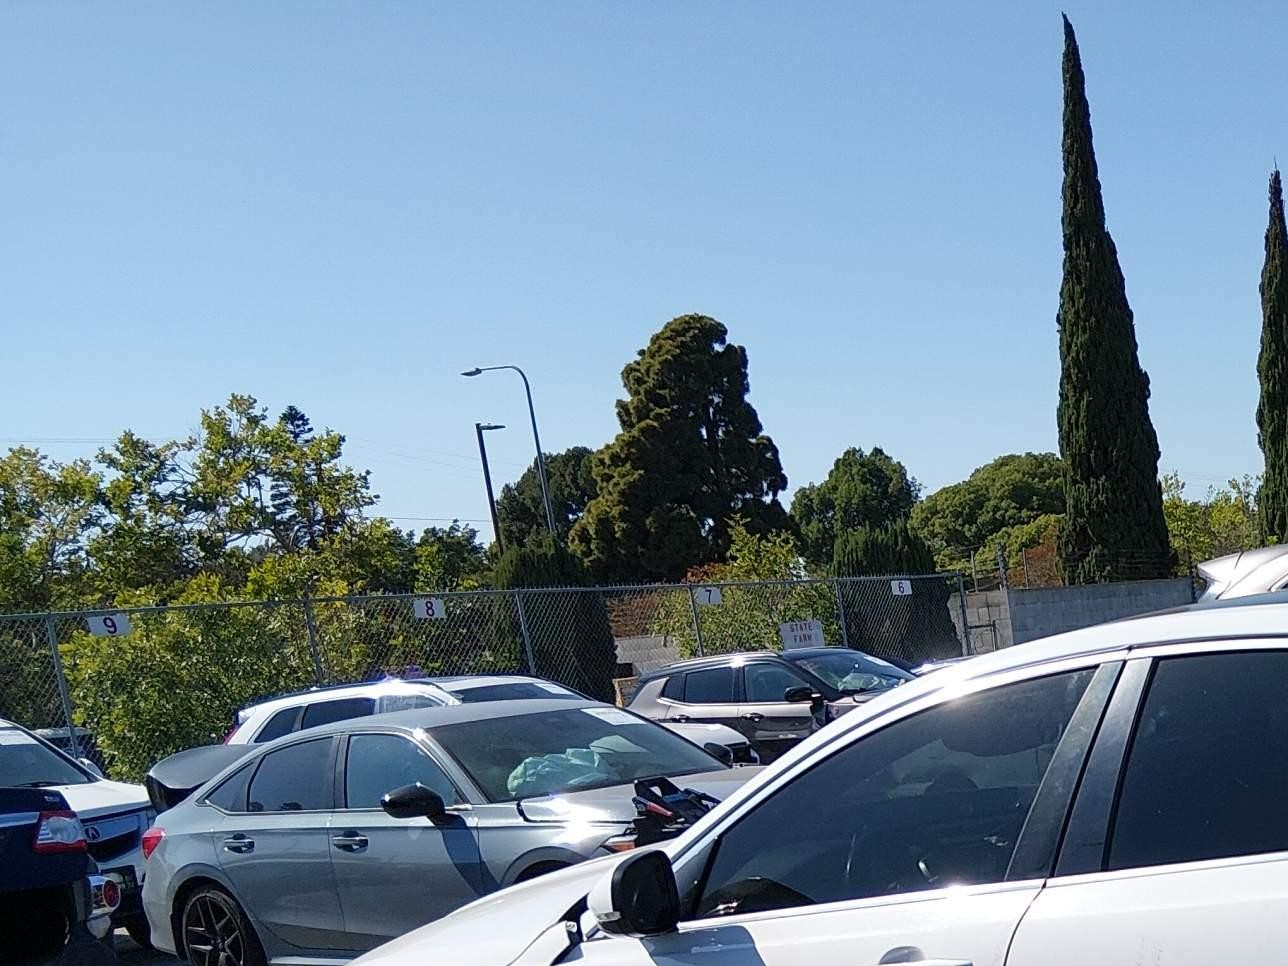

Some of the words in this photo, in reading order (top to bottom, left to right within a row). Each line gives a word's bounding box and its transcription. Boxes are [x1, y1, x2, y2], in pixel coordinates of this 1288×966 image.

[898, 581, 904, 593] 6
[705, 589, 712, 603] 7
[425, 600, 435, 617] 8
[102, 616, 117, 634] 9
[790, 622, 813, 633] STATE
